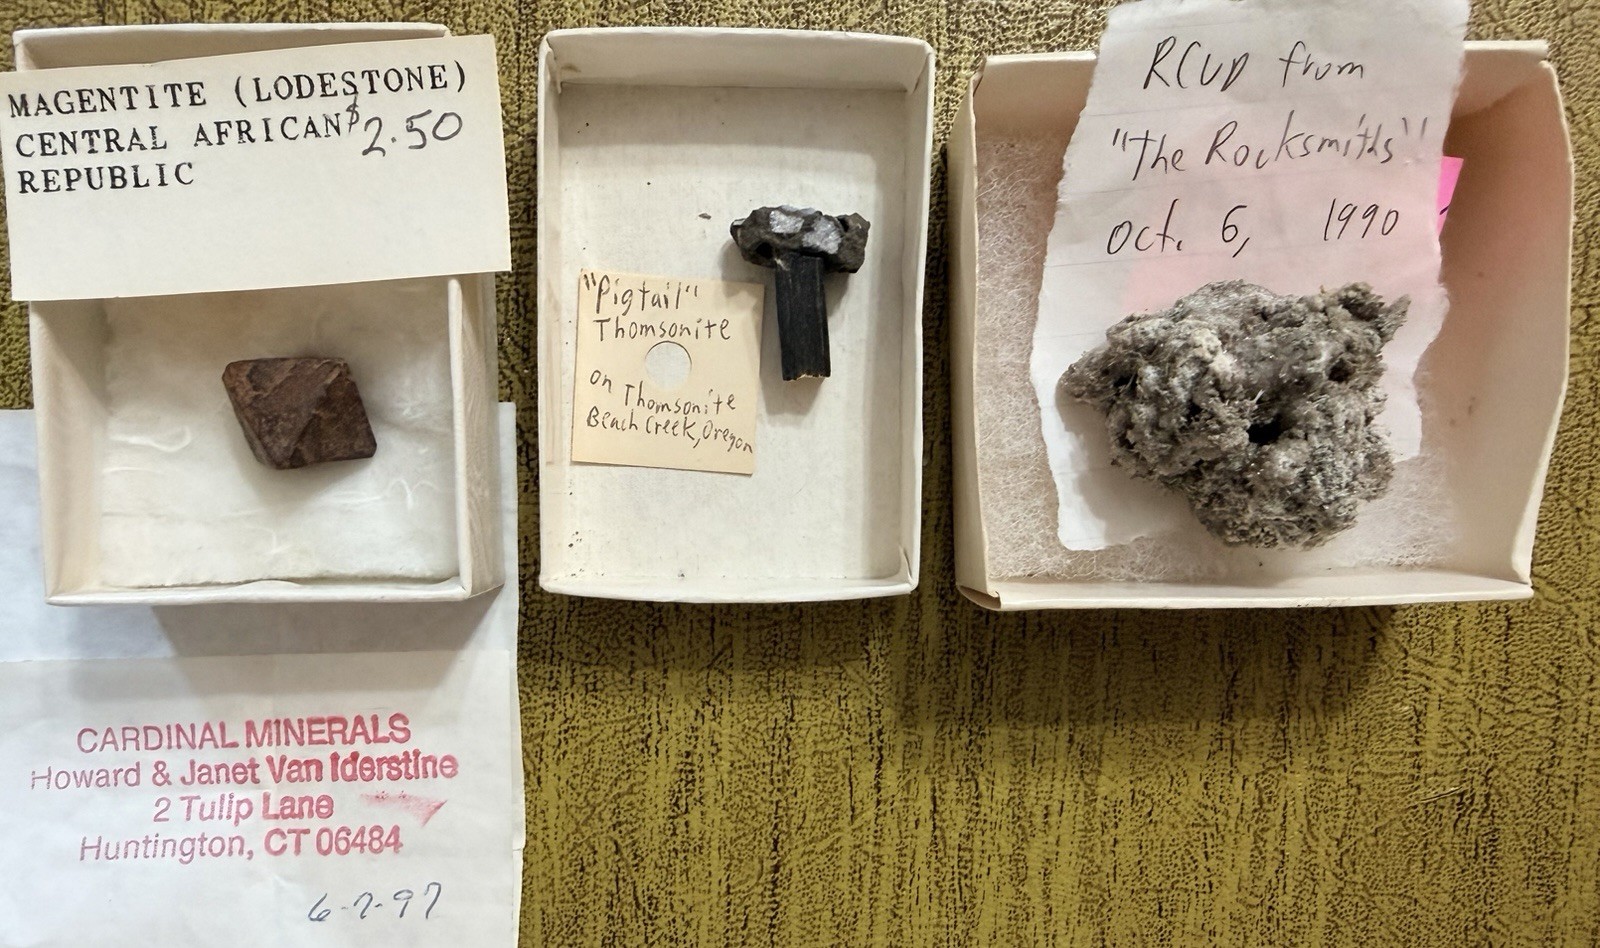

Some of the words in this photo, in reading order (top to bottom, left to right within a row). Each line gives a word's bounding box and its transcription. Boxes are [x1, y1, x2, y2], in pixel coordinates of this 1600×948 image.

[1279, 41, 1364, 88] from
[8, 81, 207, 118] MAGENTITE
[234, 60, 467, 107] (LODESTONE)
[15, 125, 168, 157] CENTRAL
[193, 112, 341, 148] AFRICAN
[18, 162, 195, 194] REPUBLIC
[1221, 205, 1250, 258] 6,
[1323, 198, 1399, 241] 1990
[593, 316, 731, 341] Thomsonite
[625, 380, 736, 416] Thomsonite
[586, 405, 638, 432] Beach
[702, 420, 753, 454] Oregon
[76, 721, 239, 754] CARDINAL
[245, 712, 412, 748] MINERALS
[31, 761, 141, 790] Howard
[151, 761, 170, 786] &
[180, 756, 259, 786] Janet
[266, 755, 324, 783] Van
[330, 748, 459, 783] Iderstine
[153, 797, 170, 823] 2
[179, 793, 253, 826] Tulip
[261, 793, 334, 820] Lane
[79, 831, 254, 866] Huntington,
[264, 828, 310, 857] CT
[315, 824, 404, 856] 06484
